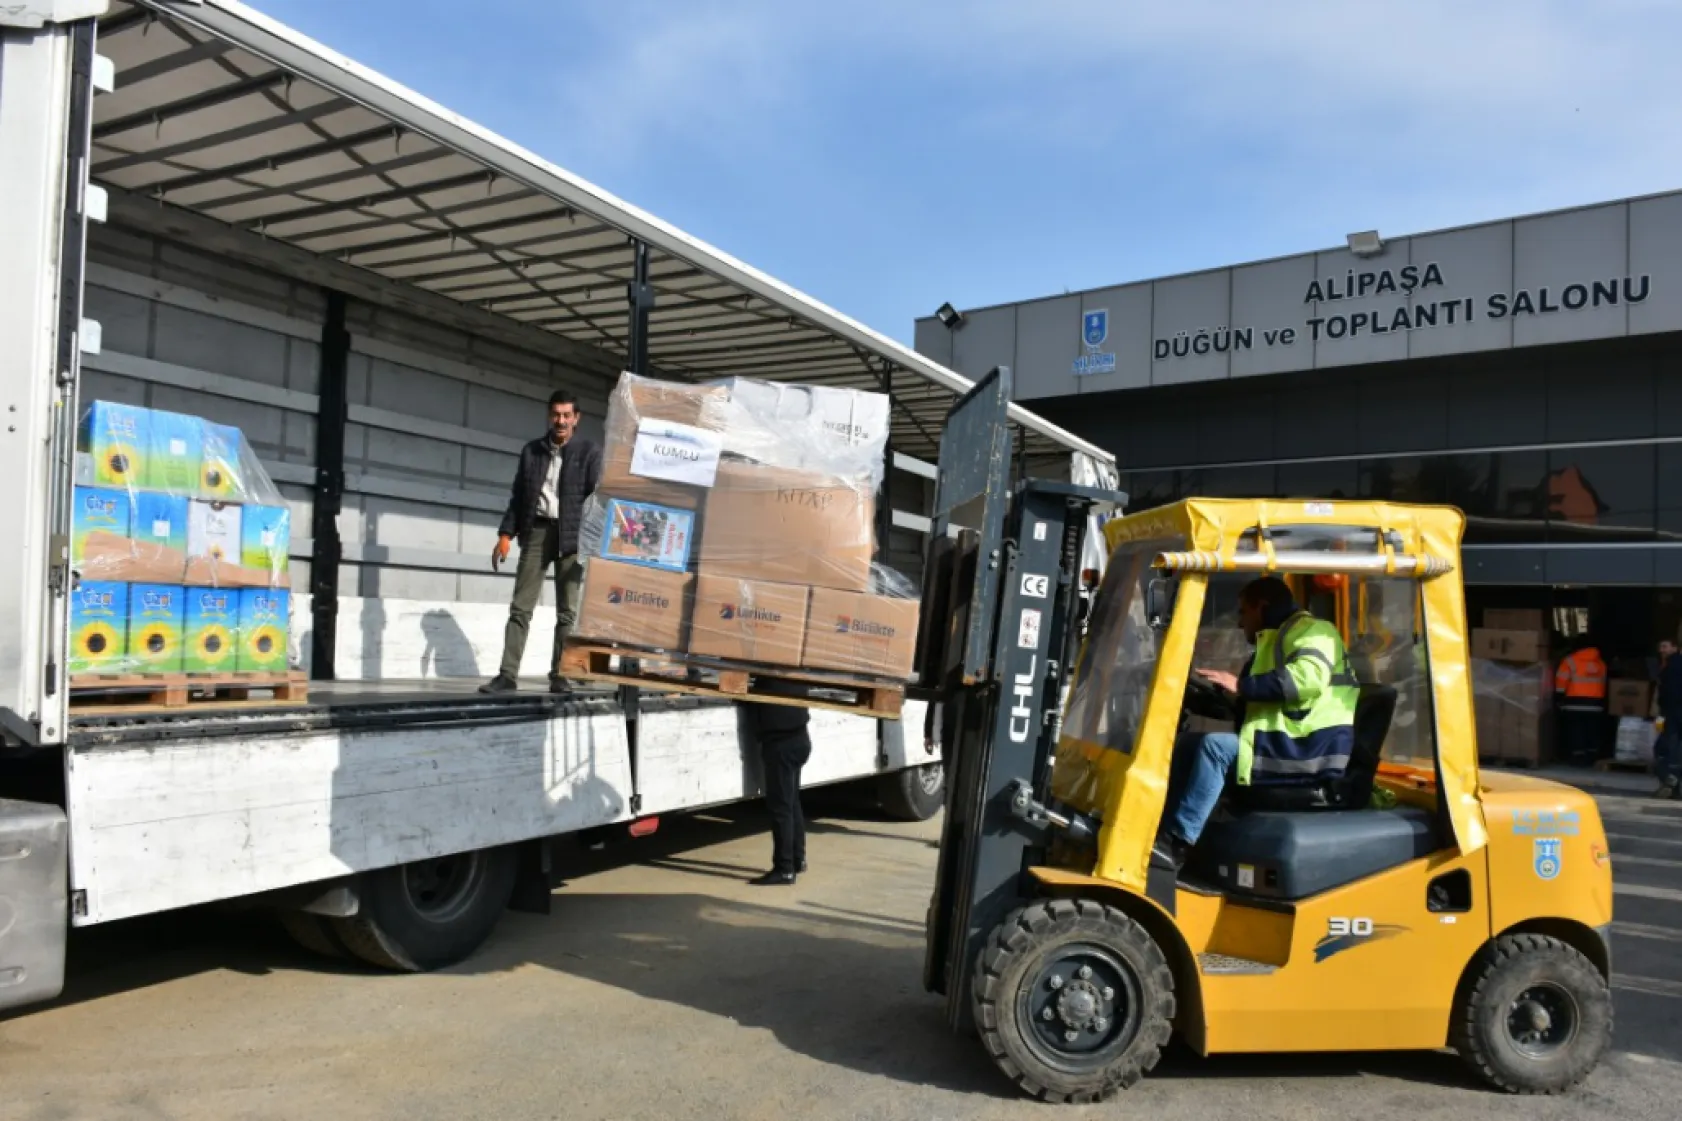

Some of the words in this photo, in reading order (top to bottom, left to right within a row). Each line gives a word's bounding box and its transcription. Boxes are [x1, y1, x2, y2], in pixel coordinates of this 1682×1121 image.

[1304, 262, 1444, 303] ALİPAŞA
[1154, 326, 1253, 359] DÜĞÜN
[1263, 327, 1296, 346] ve
[1306, 297, 1473, 341] TOPLANTI
[1486, 274, 1650, 319] SALONU
[653, 443, 700, 462] KUMLU
[625, 589, 670, 609] Birlikte
[1009, 654, 1037, 743] CHL
[1328, 916, 1375, 936] 30
